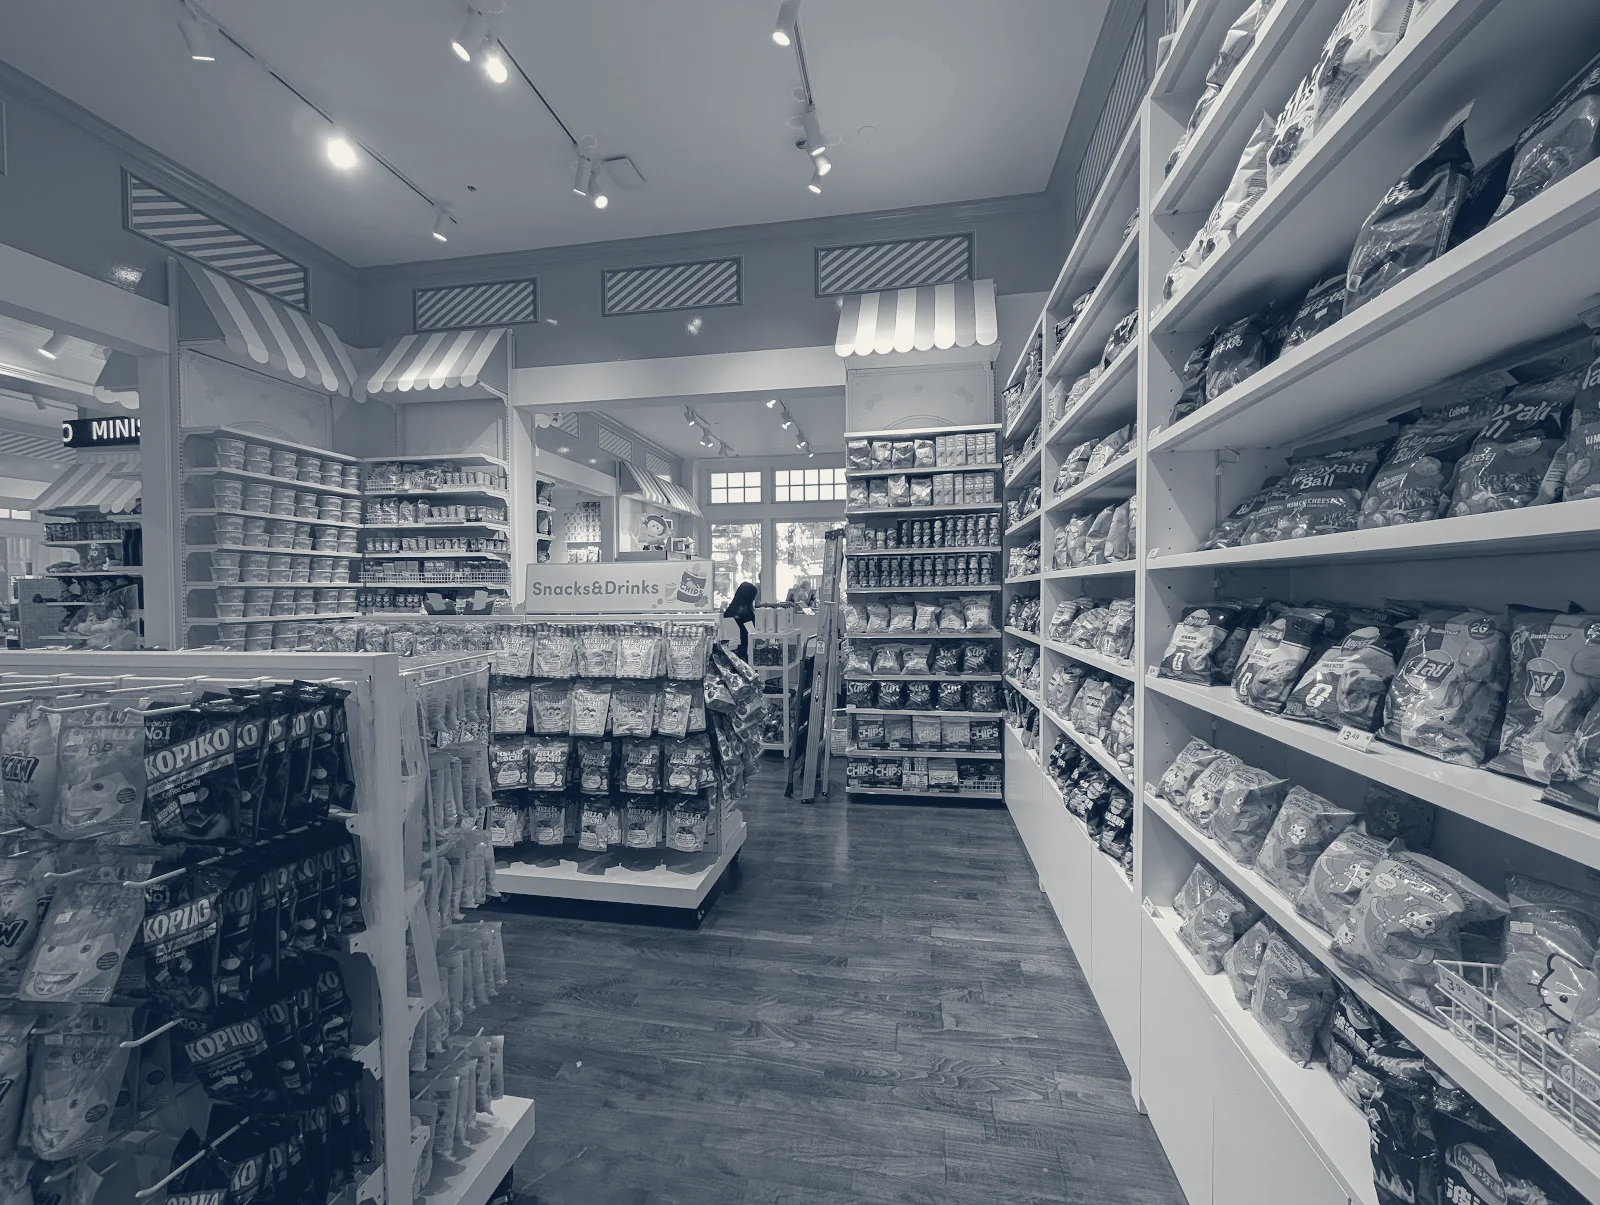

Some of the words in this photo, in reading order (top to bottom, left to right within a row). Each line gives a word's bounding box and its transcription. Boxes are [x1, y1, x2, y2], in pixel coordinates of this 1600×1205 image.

[1291, 462, 1368, 486] Taoyaki
[1300, 474, 1335, 490] Ball
[532, 579, 660, 596] Snacks&Drinks
[679, 583, 704, 596] CHIPS
[909, 682, 930, 692] Sun
[973, 683, 996, 694] Sun
[144, 726, 172, 742] No.1
[858, 727, 884, 739] CHIPS
[917, 728, 941, 741] CHIPS
[970, 727, 999, 740] CHIPS
[143, 727, 231, 782] KOPIKO
[534, 755, 562, 763] MOCHI
[671, 751, 697, 759] HELLO
[846, 764, 874, 777] CHIPS
[874, 765, 903, 777] CHIPS
[182, 779, 201, 792] Candy
[676, 811, 701, 820] HELLO
[1393, 863, 1416, 877] FRIED
[1416, 875, 1449, 897] CHEN
[1420, 884, 1445, 903] ACK
[184, 1022, 259, 1063] KOPIKO
[227, 1060, 246, 1072] Candy
